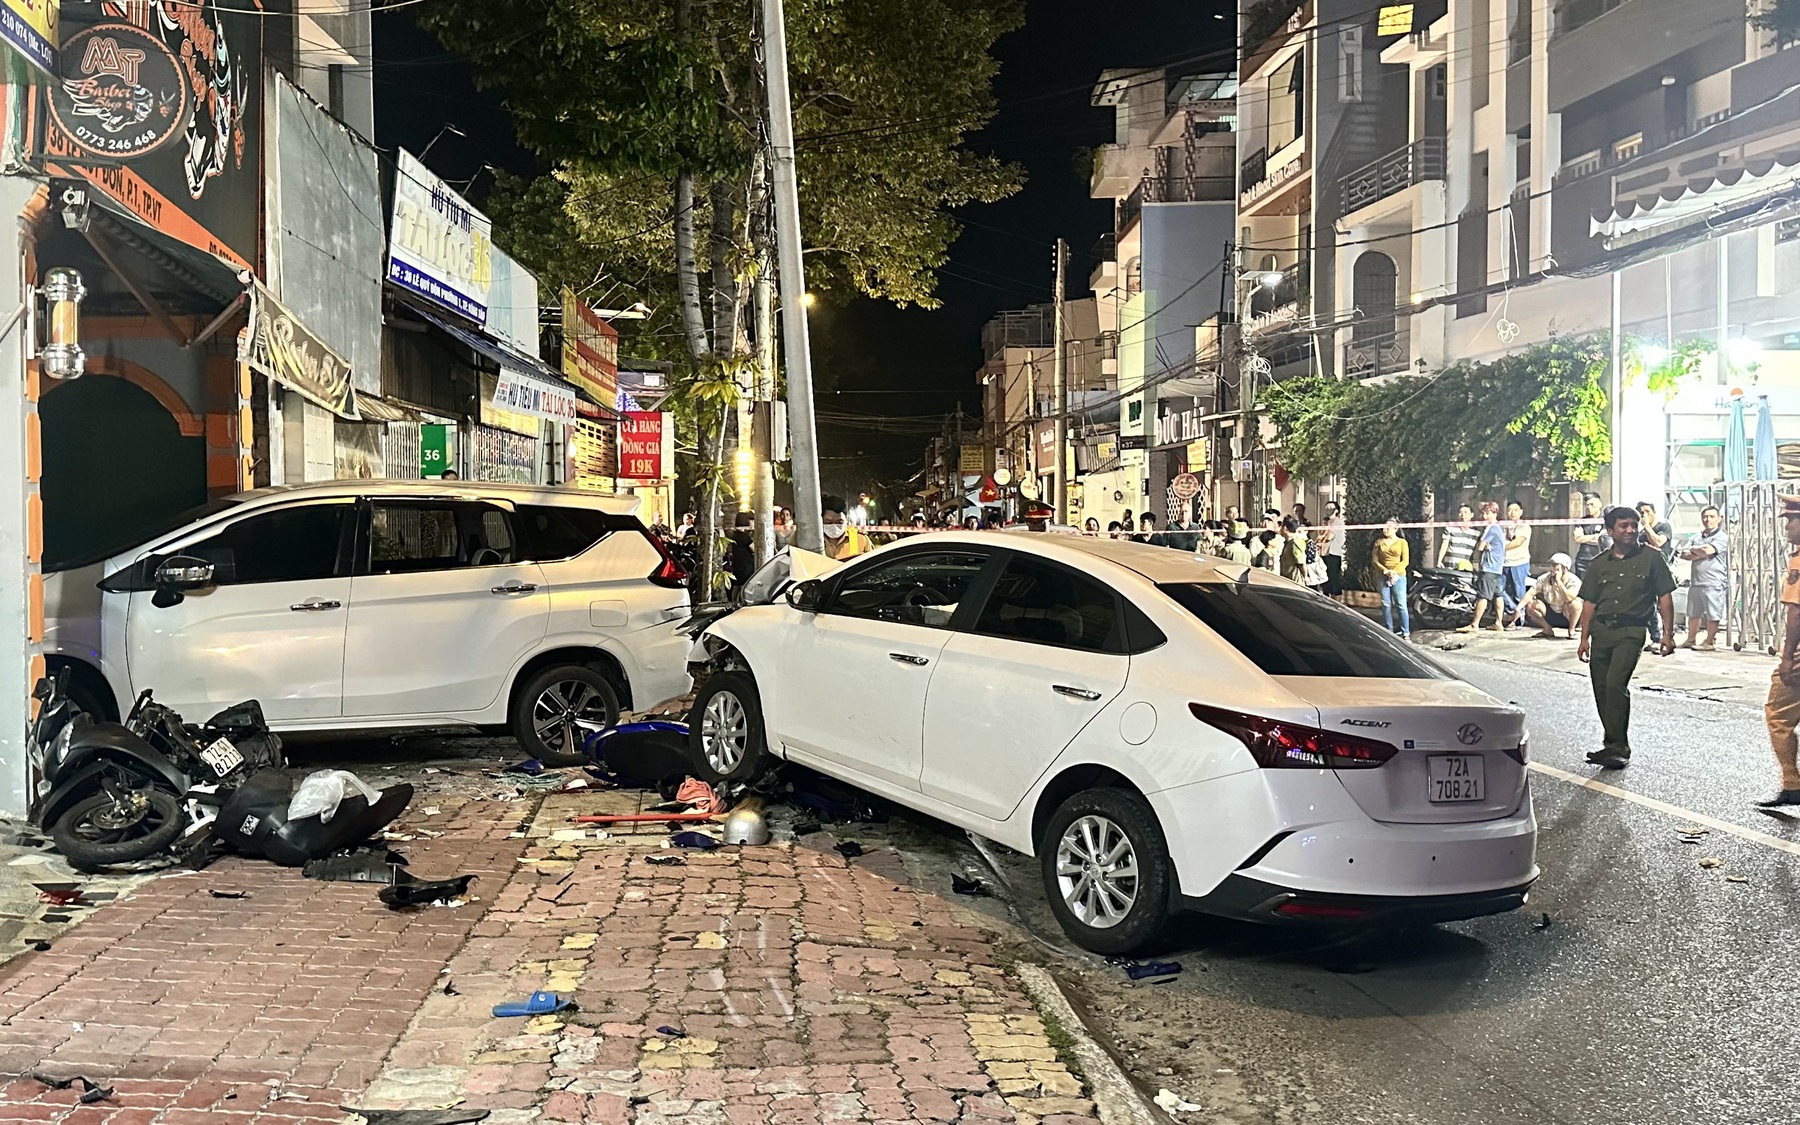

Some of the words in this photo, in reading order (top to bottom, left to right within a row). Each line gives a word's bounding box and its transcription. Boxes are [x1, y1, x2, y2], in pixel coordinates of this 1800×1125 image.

[1, 8, 15, 31] 210
[15, 21, 27, 43] 074
[81, 37, 146, 87] MT
[79, 79, 132, 98] Barber
[76, 126, 105, 148] 0773
[108, 139, 132, 150] 246
[134, 129, 157, 147] 468
[639, 416, 661, 433] HÀNG
[1154, 405, 1181, 448] ĐỨC
[1181, 395, 1205, 441] HẢI
[424, 449, 440, 461] 36
[645, 438, 661, 455] GIÁ
[629, 459, 654, 473] 19K
[1340, 718, 1392, 729] ACCENT
[1446, 758, 1469, 777] 72A
[1436, 780, 1478, 800] 708.21
